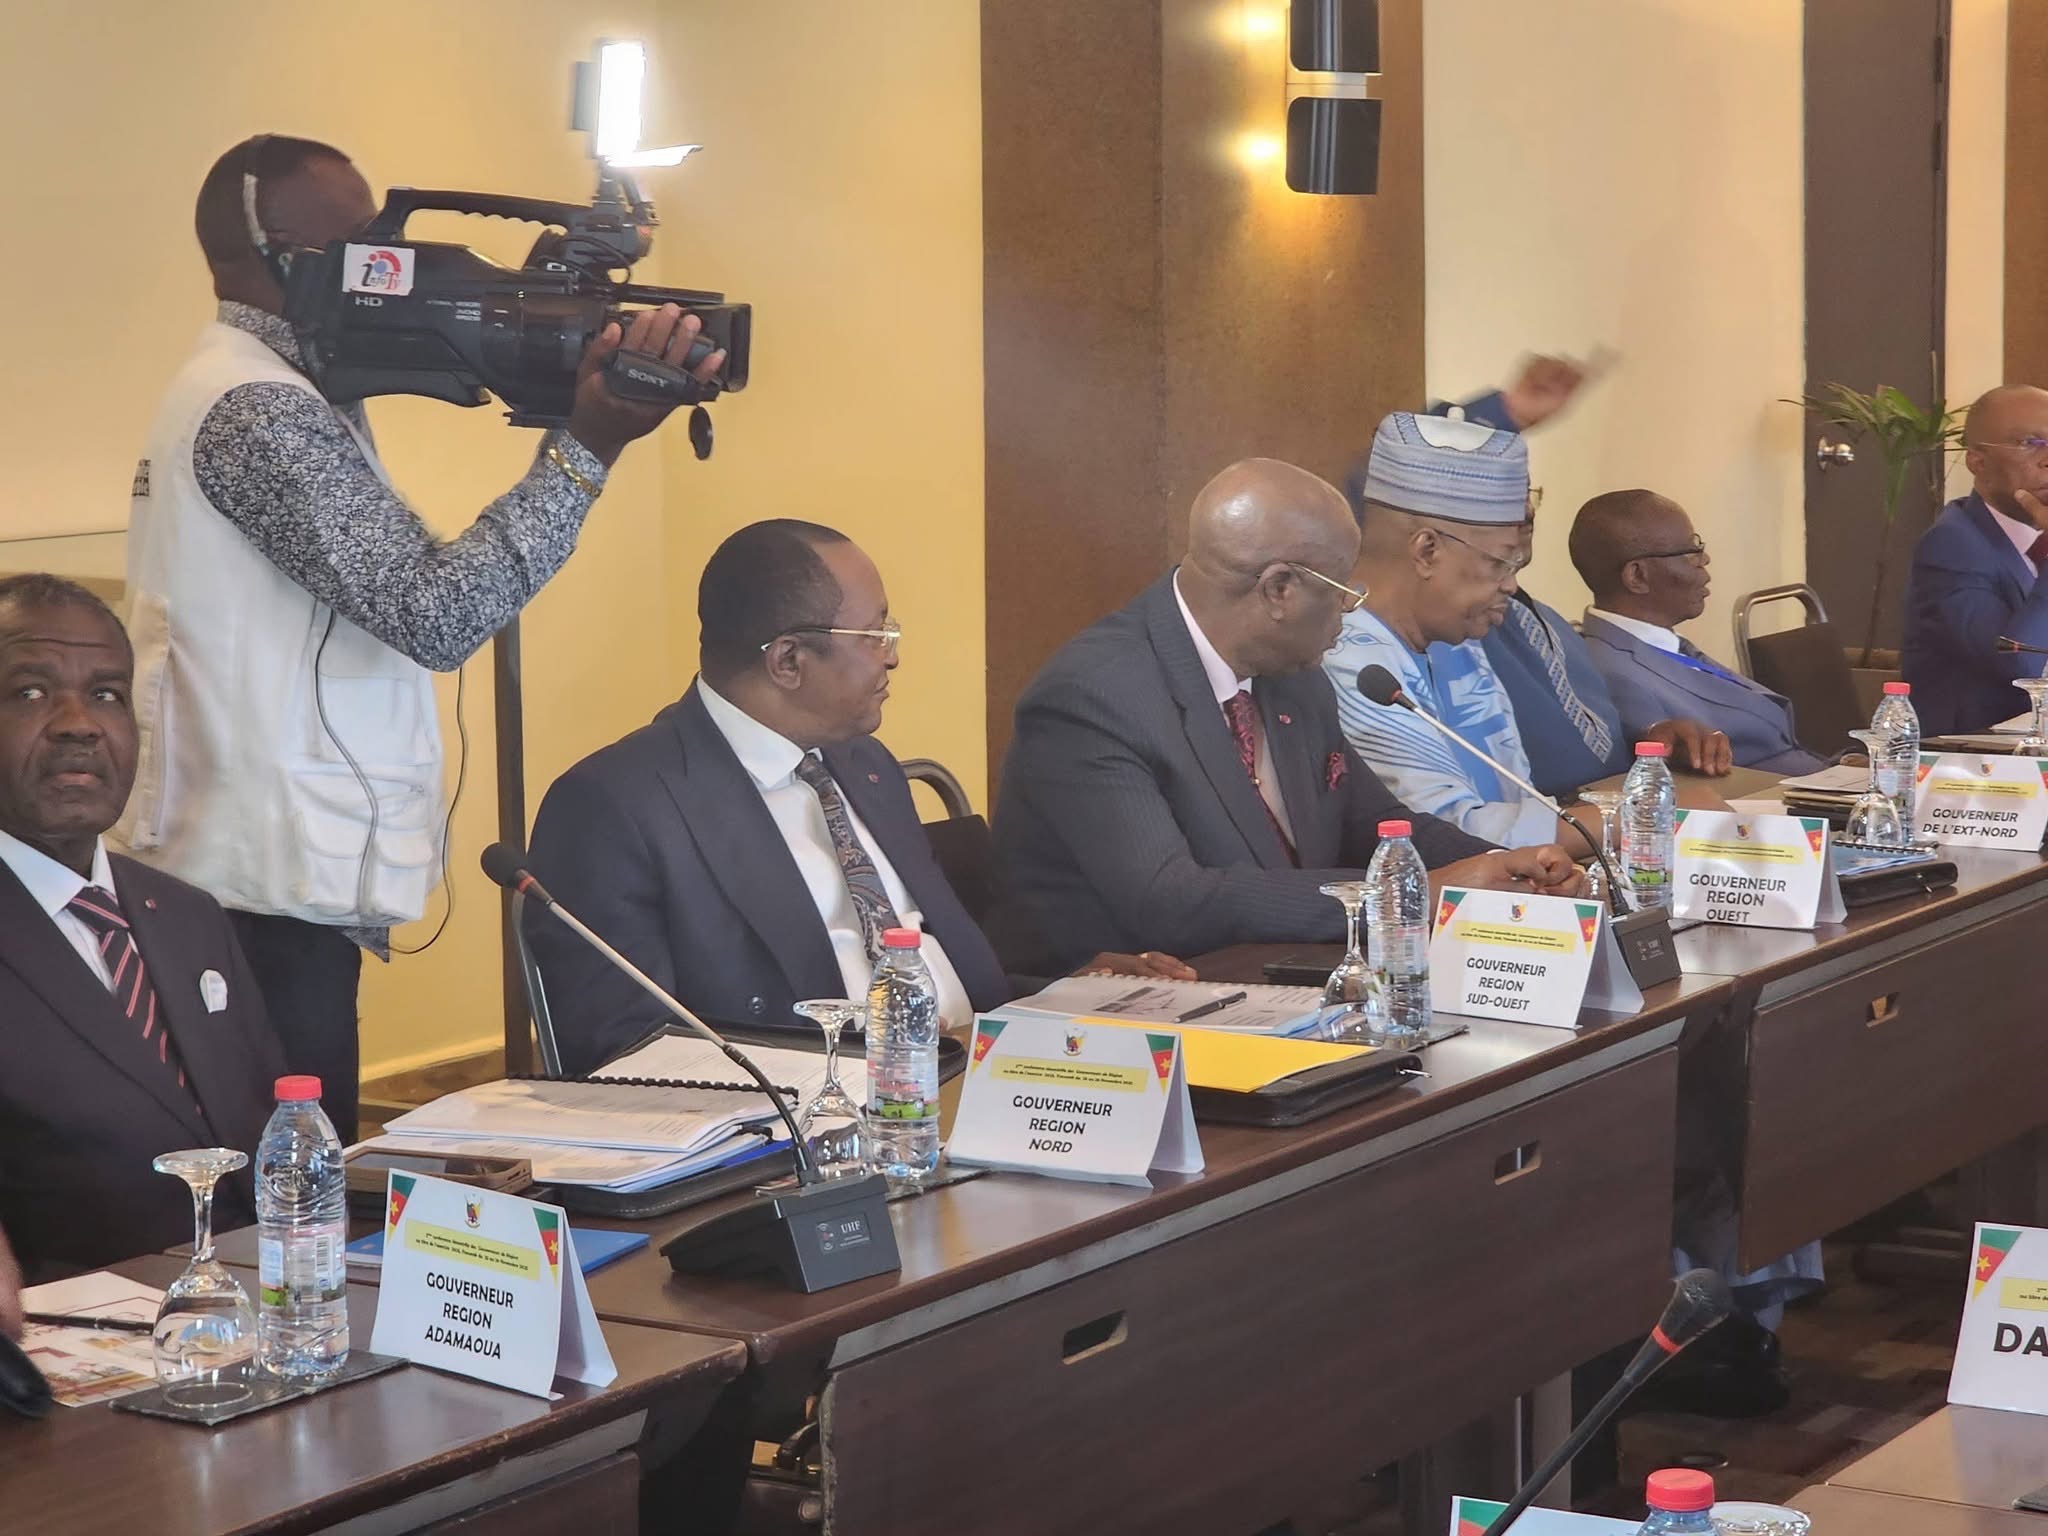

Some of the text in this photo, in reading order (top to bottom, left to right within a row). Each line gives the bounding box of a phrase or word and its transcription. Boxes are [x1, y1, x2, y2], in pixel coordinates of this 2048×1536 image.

[355, 296, 383, 307] HD
[627, 368, 669, 388] SONY
[1932, 808, 2018, 822] GOUVERNEUR
[1922, 823, 2017, 837] DE L'EXT-NORD
[1689, 873, 1787, 892] GOUVERNEUR
[1706, 890, 1765, 907] REGION
[1706, 909, 1750, 923] OUEST
[1466, 957, 1546, 977] GOUVERNEUR
[1478, 976, 1524, 992] REGION
[1466, 992, 1530, 1011] SUD-OUEST
[1012, 1095, 1112, 1116] GOUVERNEUR
[1029, 1118, 1085, 1134] REGION
[1029, 1138, 1072, 1153] NORD
[840, 1220, 861, 1234] UHF
[426, 1271, 514, 1309] GOUVERNEUR
[443, 1302, 492, 1329] REGION
[424, 1325, 501, 1360] ADAMAOUA
[1993, 1322, 2048, 1356] DA
